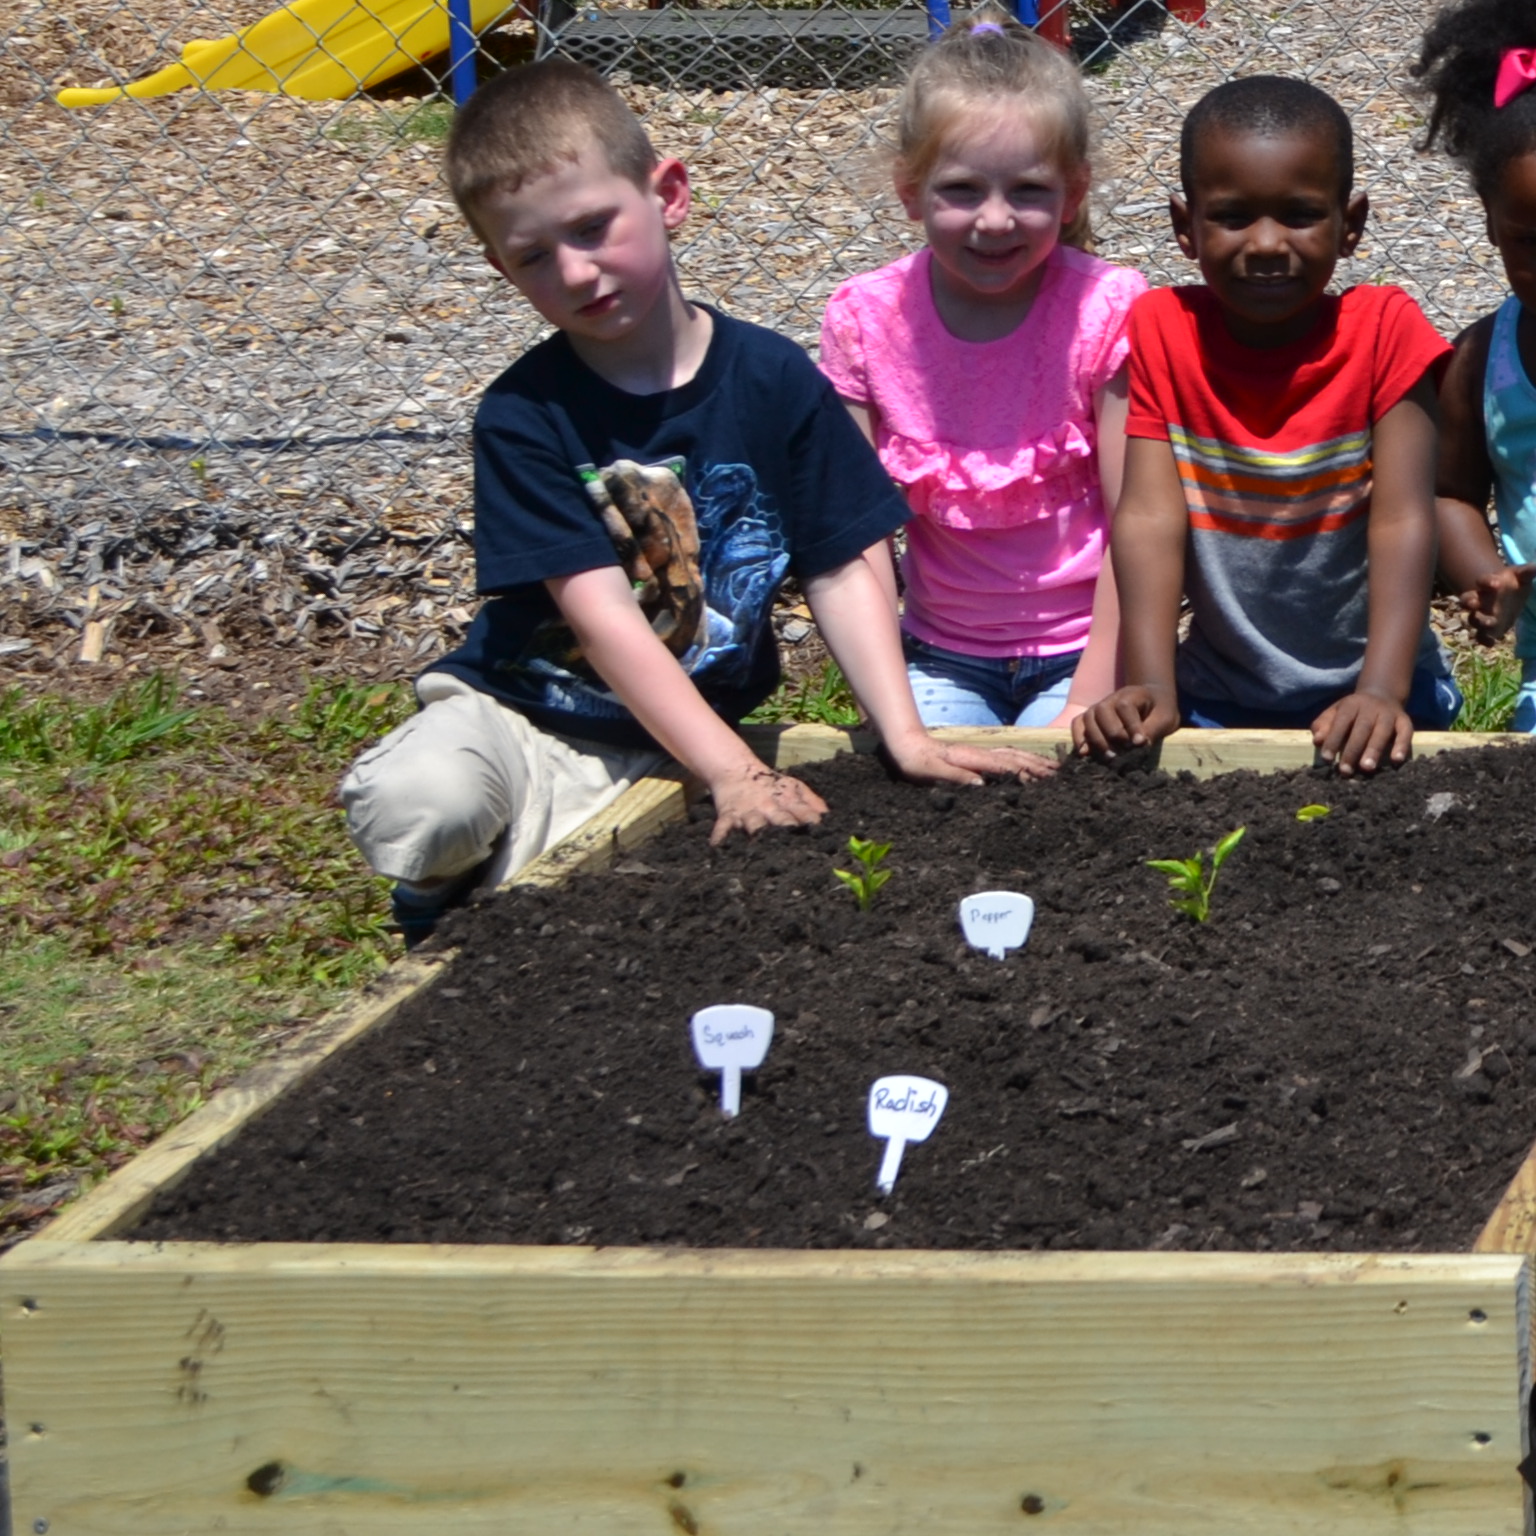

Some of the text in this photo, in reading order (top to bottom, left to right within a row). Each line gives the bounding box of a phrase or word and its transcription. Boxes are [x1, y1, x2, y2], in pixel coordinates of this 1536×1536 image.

[970, 907, 1013, 924] Pepper
[702, 1023, 755, 1048] Squash
[874, 1085, 938, 1118] Radish
